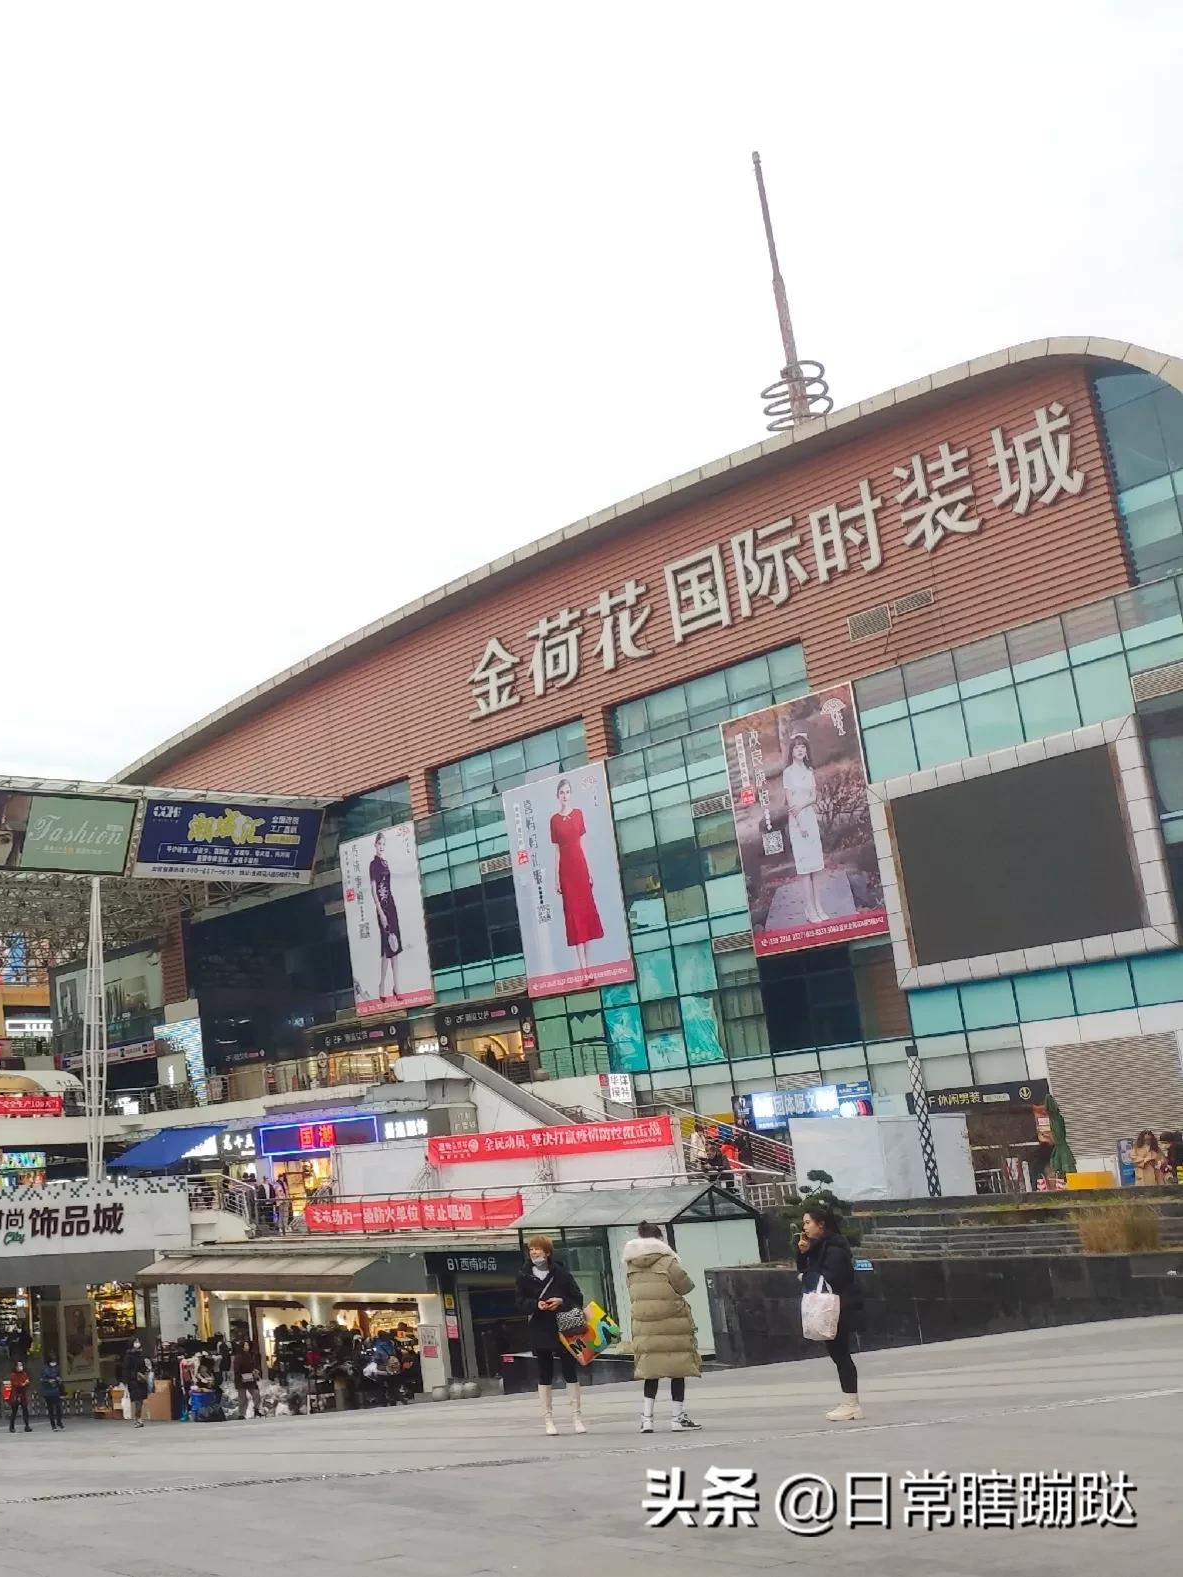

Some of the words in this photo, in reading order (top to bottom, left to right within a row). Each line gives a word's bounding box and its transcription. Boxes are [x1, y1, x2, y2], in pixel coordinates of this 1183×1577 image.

[28, 814, 122, 845] Fashion
[937, 1091, 982, 1106] 休闲男装
[28, 1202, 125, 1239] 饰品城
